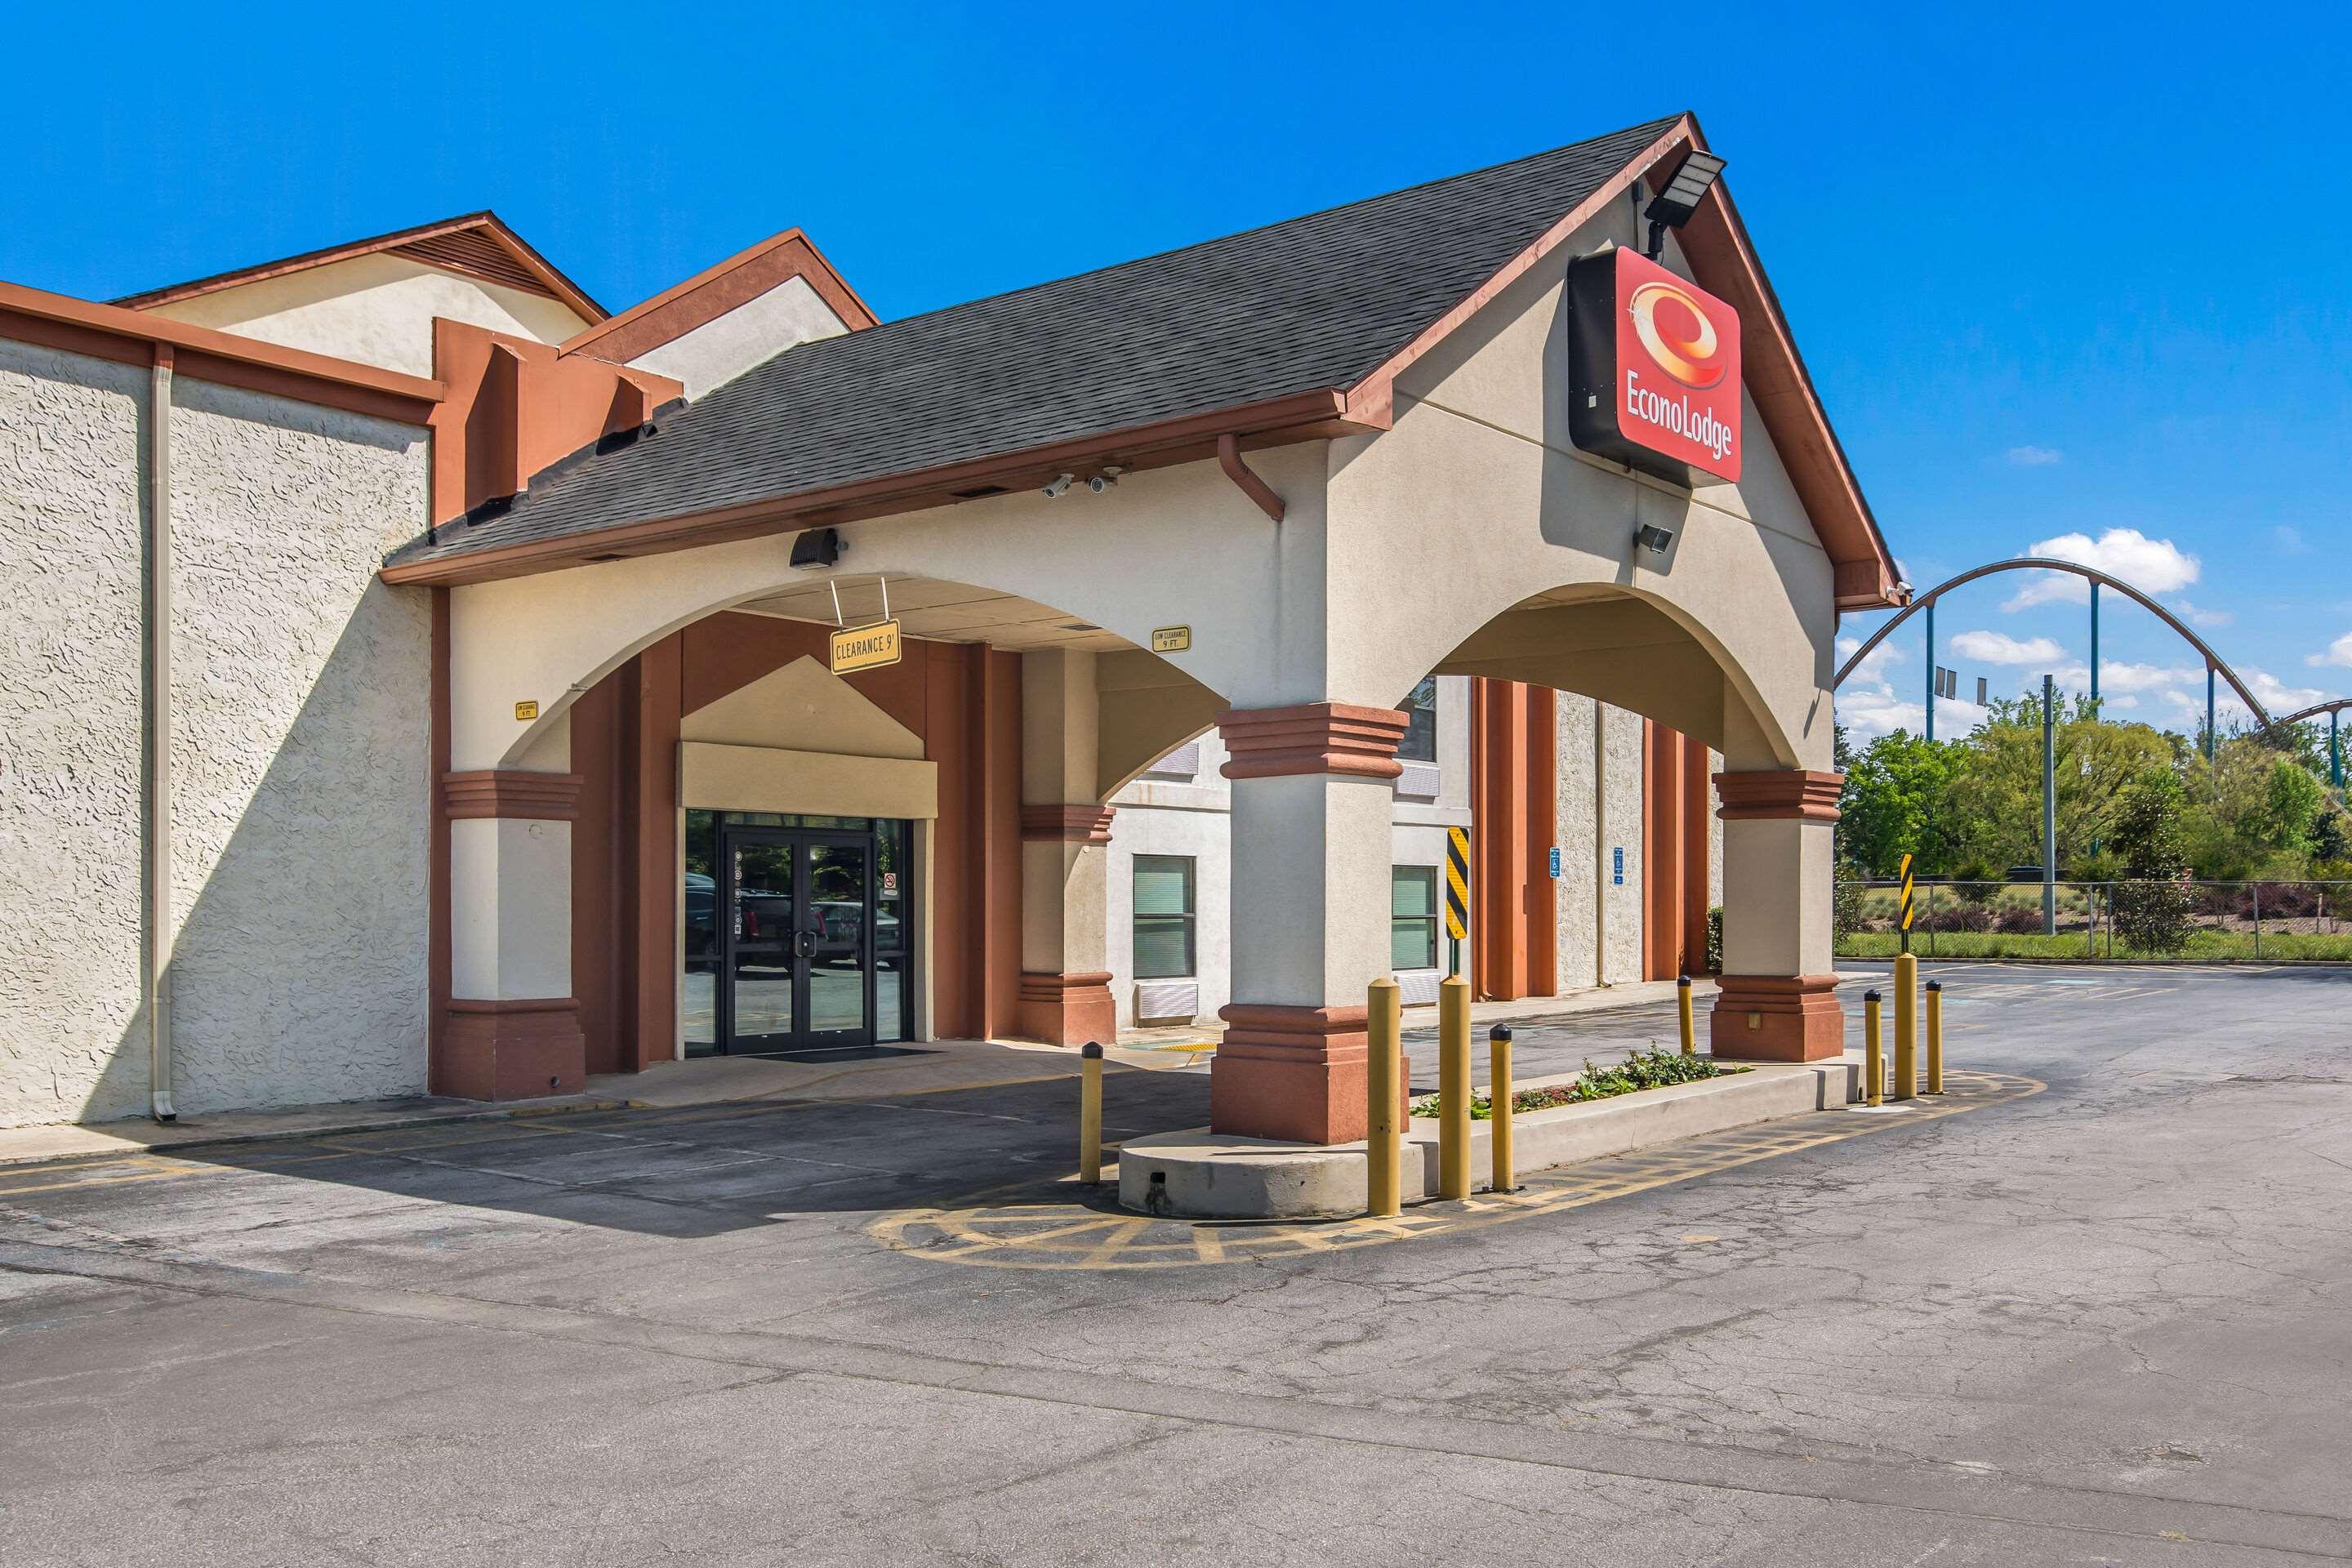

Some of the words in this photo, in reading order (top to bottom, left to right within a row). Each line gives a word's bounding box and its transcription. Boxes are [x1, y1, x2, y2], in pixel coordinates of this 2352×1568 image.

[1627, 369, 1732, 460] EconoLodge
[835, 636, 884, 660] CLEARANCE
[887, 634, 894, 650] 9'
